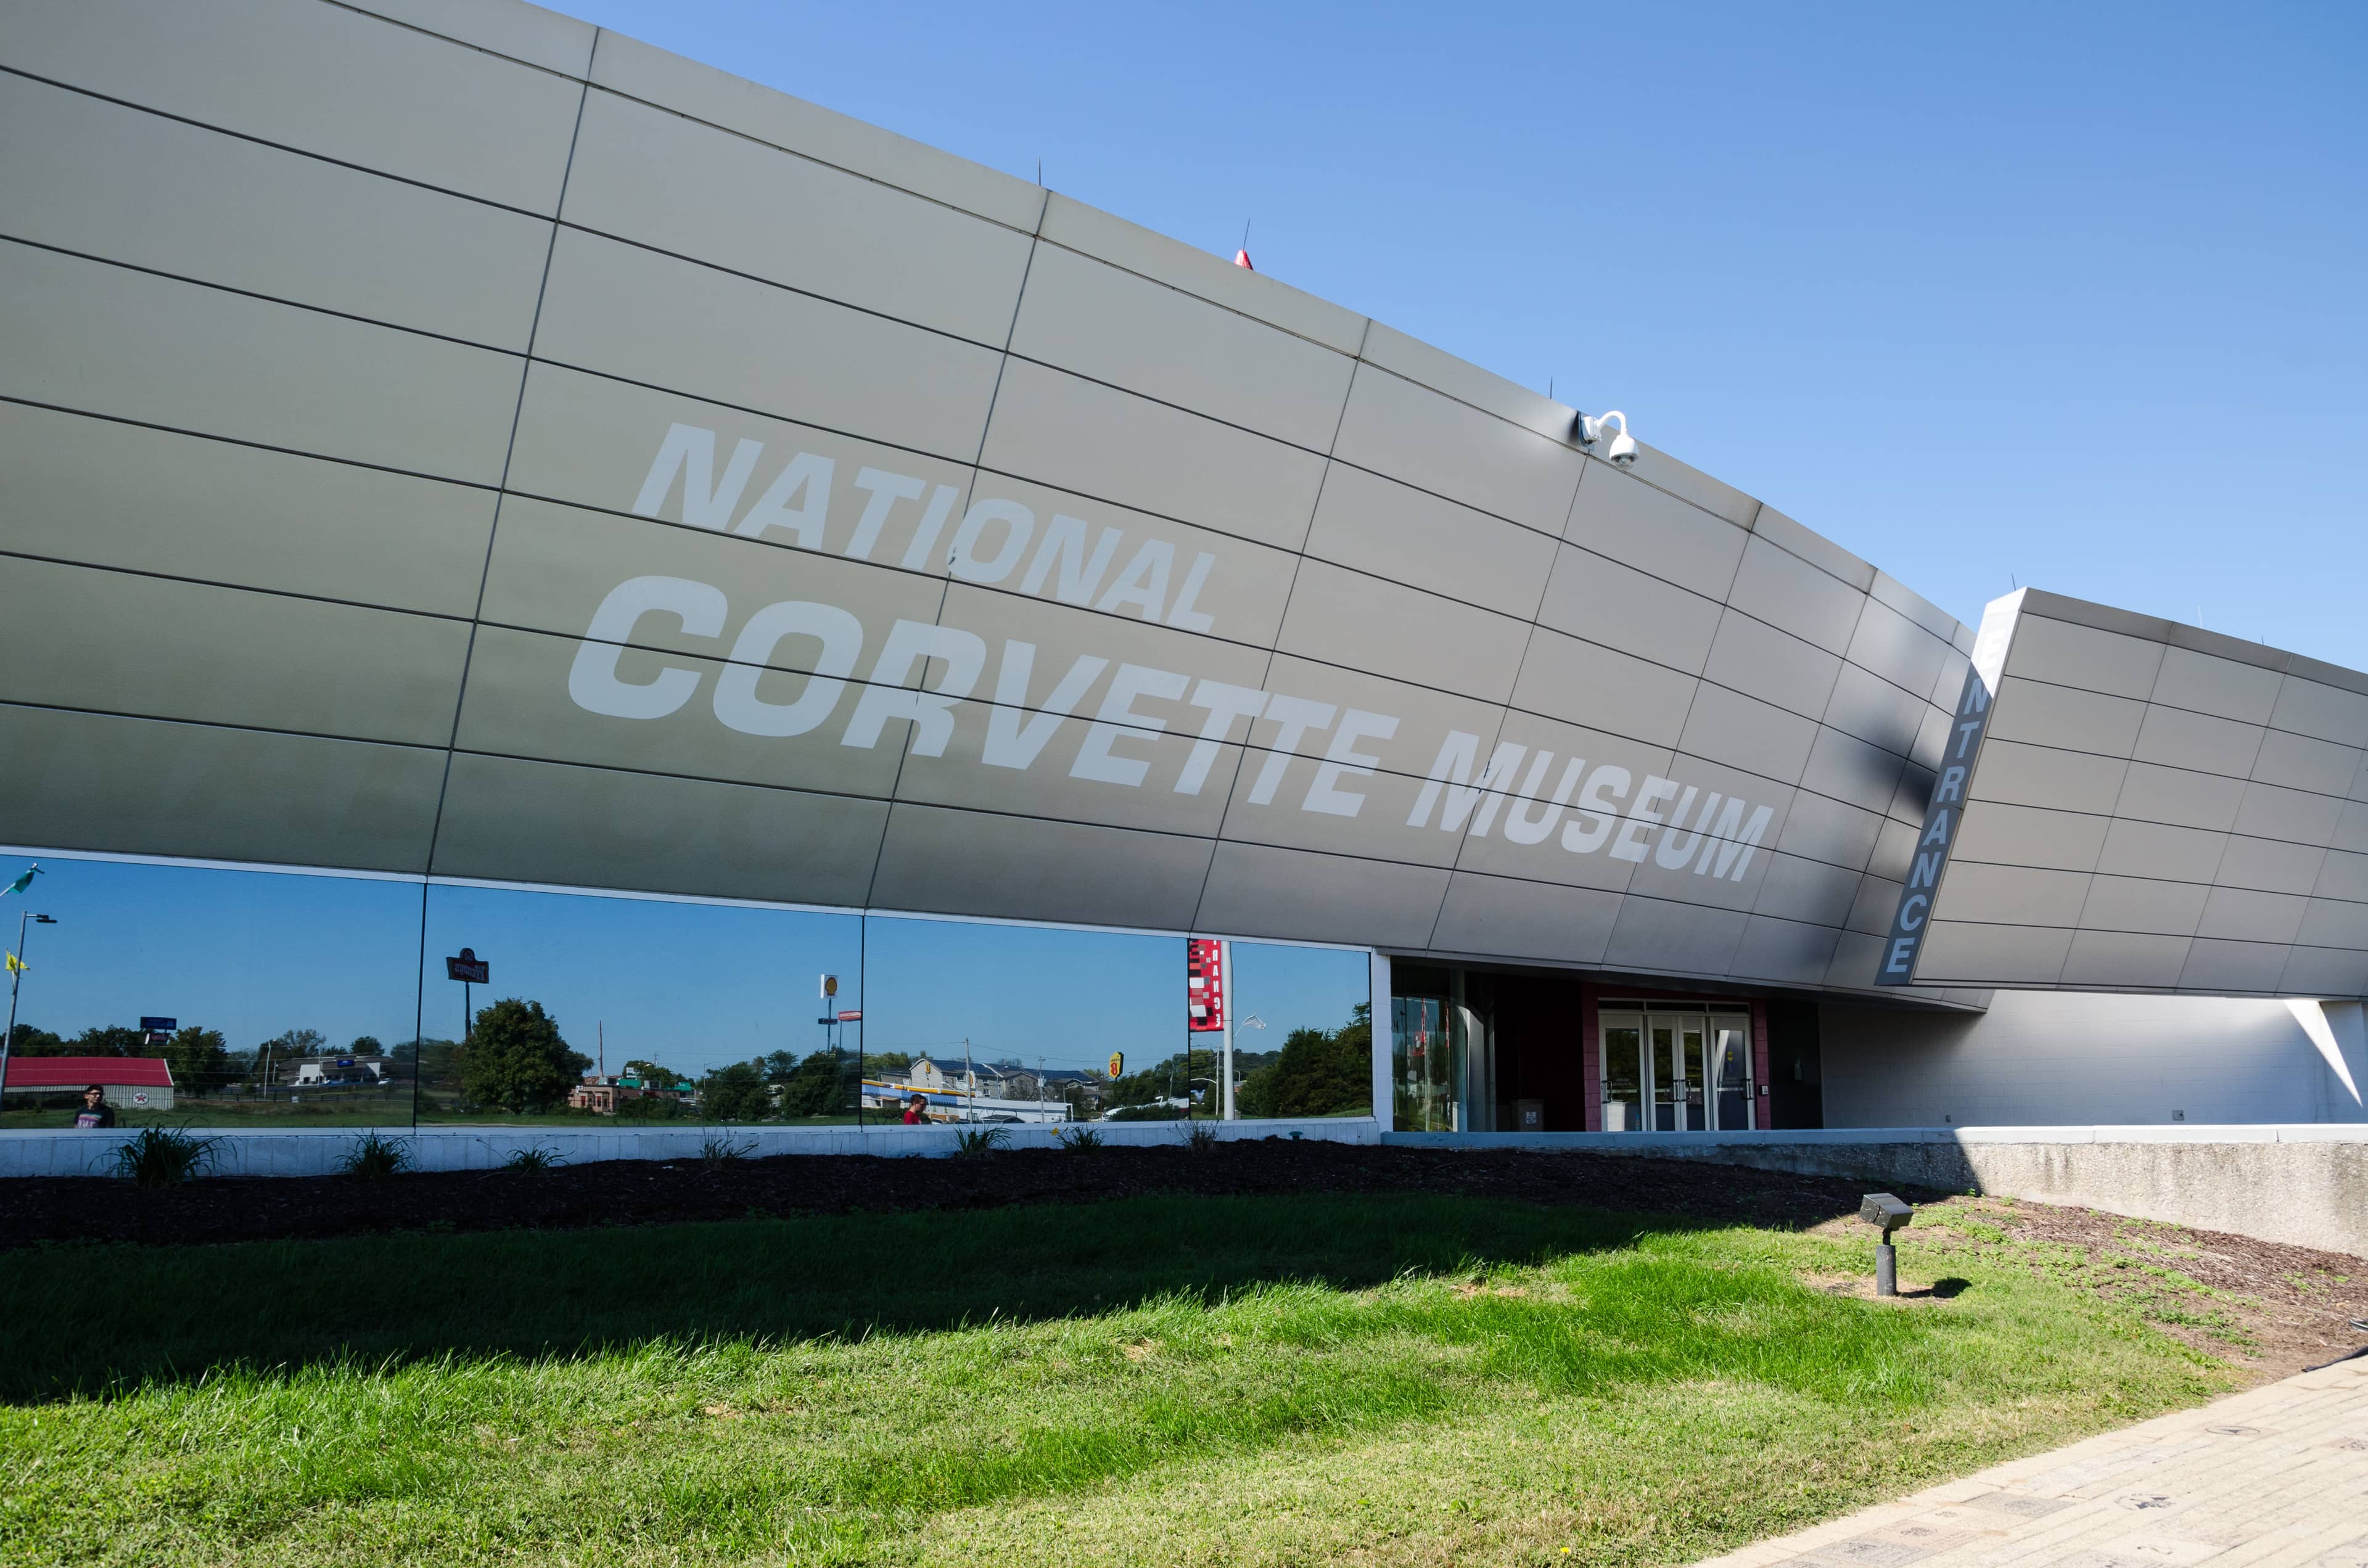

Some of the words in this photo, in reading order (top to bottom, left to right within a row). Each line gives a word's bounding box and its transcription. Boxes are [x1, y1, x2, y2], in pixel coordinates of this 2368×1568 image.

[631, 422, 1216, 634] NATIONAL
[568, 575, 1400, 818] CORVETTE
[1406, 729, 1774, 882] MUSEUM
